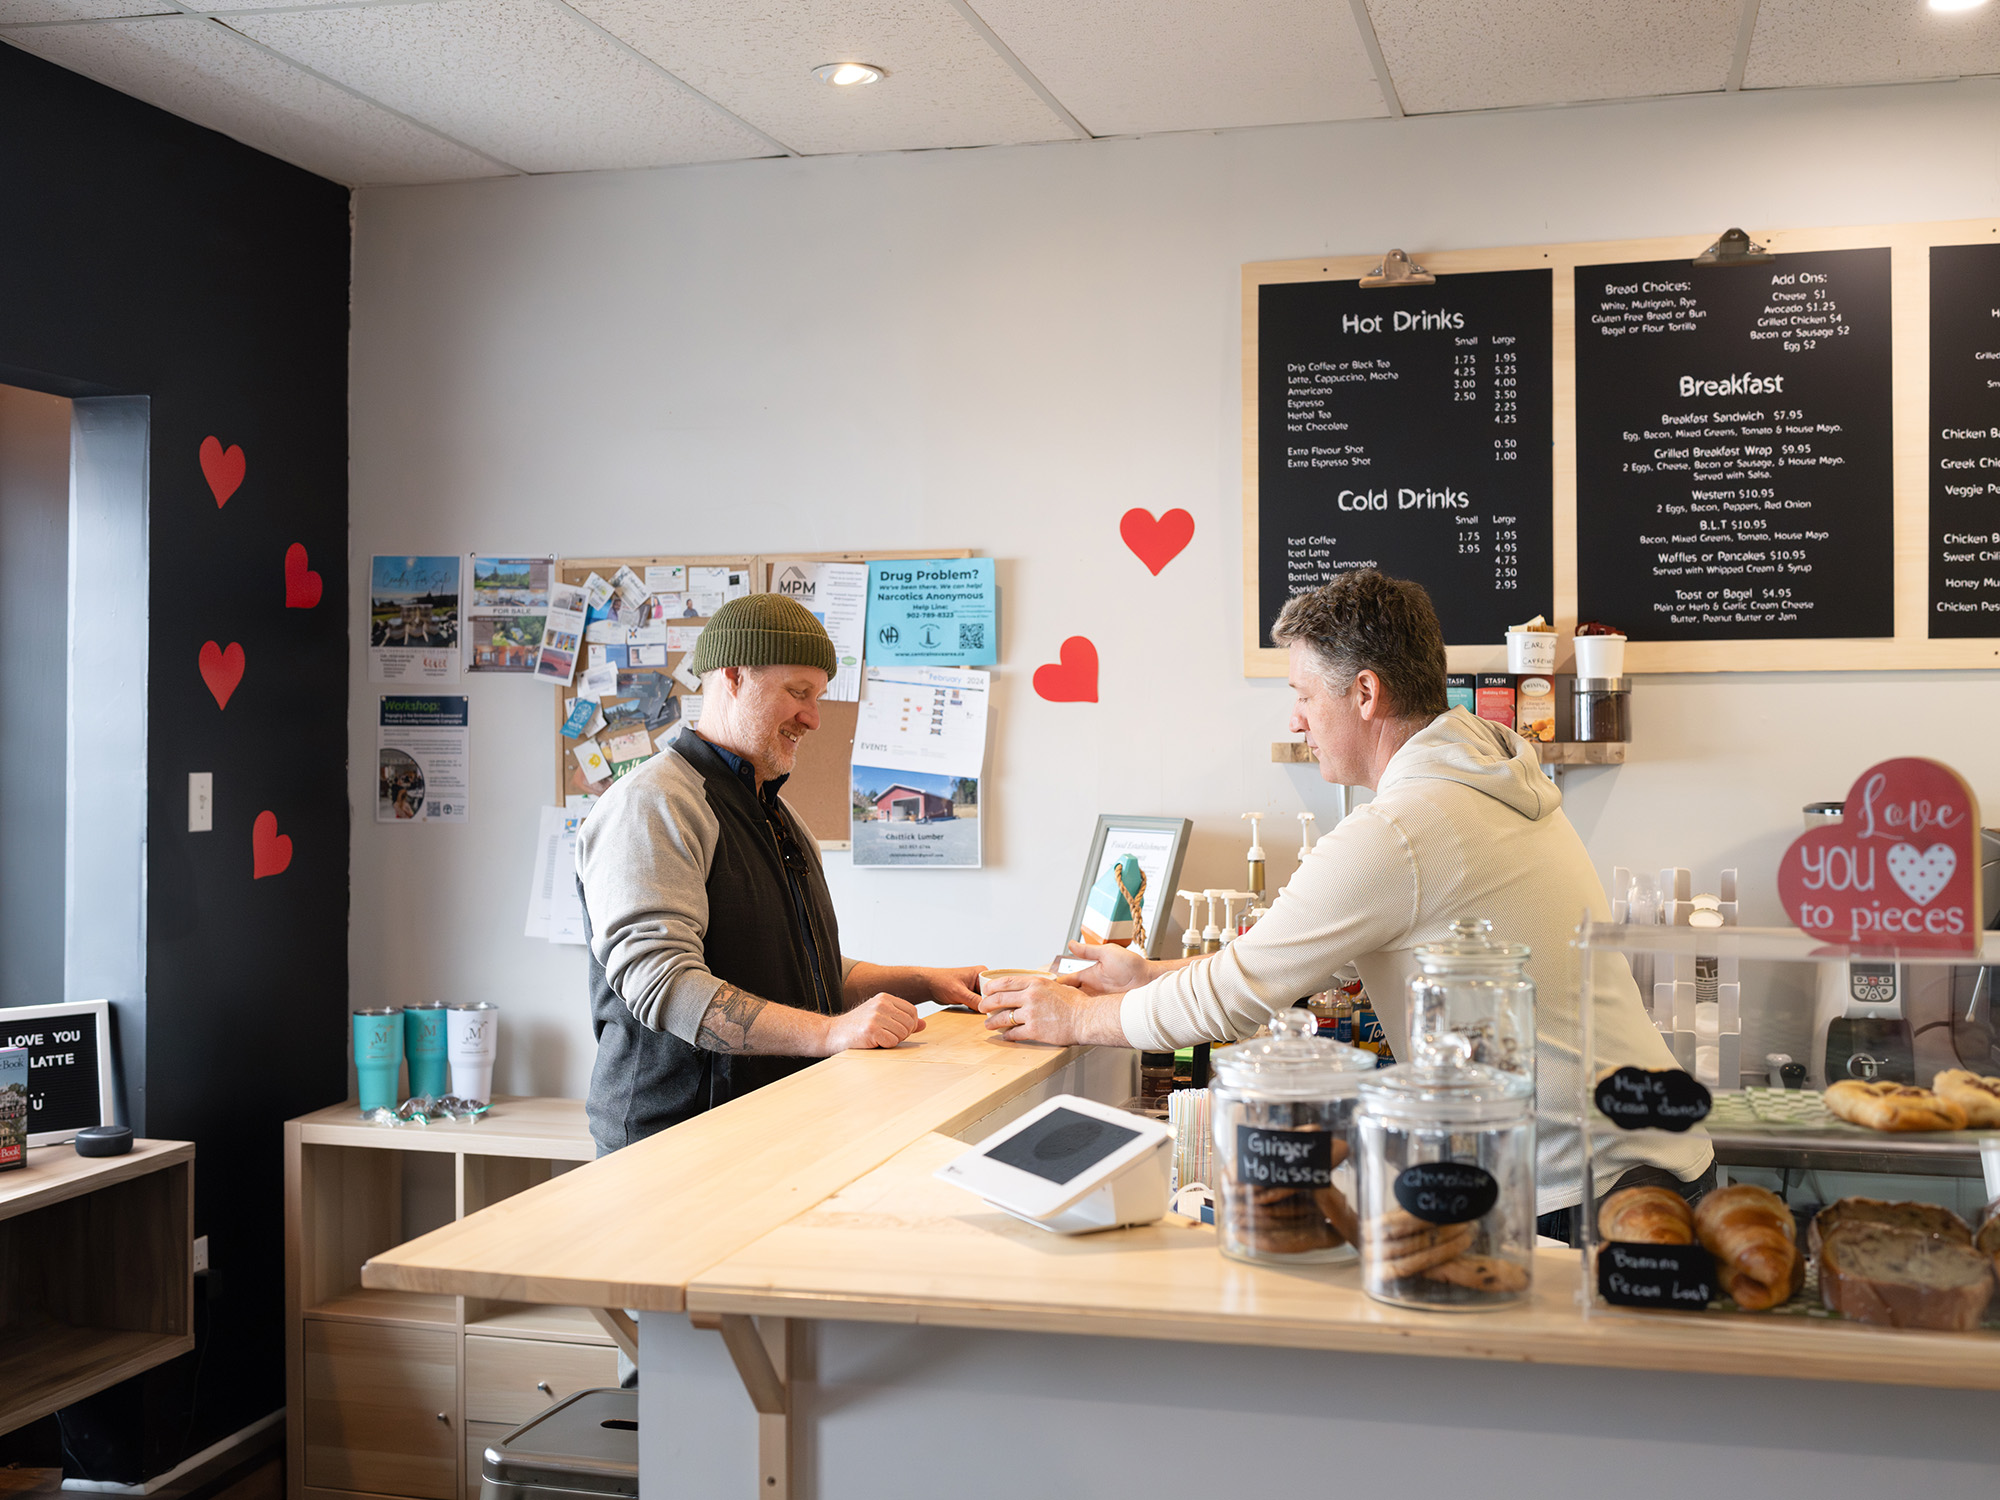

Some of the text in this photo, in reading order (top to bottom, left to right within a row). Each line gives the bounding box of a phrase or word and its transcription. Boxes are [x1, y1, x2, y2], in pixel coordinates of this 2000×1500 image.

[1771, 272, 1827, 285] Add Ons:
[1605, 281, 1691, 295] Bread Choices:
[1772, 289, 1825, 301] Cheese $1
[1764, 301, 1836, 314] Avocado $1.25
[1342, 308, 1464, 334] Hot Drinks
[1757, 313, 1842, 327] Grilled Chicken $4
[1455, 336, 1516, 346] Small Large
[1784, 340, 1816, 352] Egg $2
[1455, 353, 1516, 364] 1.75 1.95
[1287, 363, 1306, 373] Drip
[1308, 362, 1336, 371] Coffee
[1352, 360, 1373, 369] Black
[1376, 359, 1390, 368] Tea
[1454, 365, 1517, 376] 4.25 5.25
[1288, 371, 1399, 384] Latte, Cappuccino, Mocha
[1454, 378, 1516, 389] 3.00 4.00
[1679, 372, 1784, 397] Breakfast
[1288, 387, 1333, 396] Americano
[1454, 390, 1517, 401] 2.50 3.50
[1287, 399, 1325, 409] Espresso
[1495, 402, 1517, 412] 2.25
[1287, 410, 1332, 420] Herbal Tea
[1494, 414, 1517, 423] 4.25
[1661, 410, 1803, 425] Breakfast Sandwich $7.95
[1287, 422, 1348, 432] Hot Chocolate
[1942, 429, 1986, 439] Chicken
[1494, 439, 1517, 448] 0.50
[1287, 445, 1364, 456] Extra Flavour Shot
[1496, 451, 1517, 461] 1.00
[1654, 444, 1811, 459] Grilled Breakfast Wrap $9.95
[1287, 457, 1371, 469] Extra Espresso Shot
[1941, 458, 1975, 469] Greek
[1692, 488, 1774, 500] Western $10.95
[1945, 484, 1983, 498] Veggie
[1338, 487, 1469, 511] Cold Drinks
[1455, 515, 1516, 525] Small Large
[1700, 519, 1767, 530] B.L.T $10.95
[1288, 536, 1336, 546] Iced Coffee
[1459, 531, 1517, 541] 1.75 1.95
[1943, 533, 1988, 544] Chicken
[1288, 549, 1330, 558] Iced Latte
[1458, 543, 1517, 554] 3.95 4.95
[1495, 555, 1517, 565] 4.75
[1658, 550, 1806, 563] Waffles or Pancakes $10.95
[1943, 552, 1975, 562] Sweet
[1288, 559, 1378, 570] Peach Tea Lemonade
[880, 569, 979, 583] Drug Problem?
[1288, 572, 1319, 582] Bottled
[1495, 568, 1517, 577] 2.50
[780, 581, 816, 595] MPM
[1495, 580, 1517, 589] 2.95
[1945, 578, 1980, 590] Honey
[878, 592, 984, 602] Narcotics Anonymous
[1675, 588, 1792, 601] Toast or Bagel $4.95
[1936, 602, 1978, 612] Chicken
[1524, 641, 1545, 650] EARL
[929, 673, 984, 685] February 2024
[384, 701, 440, 713] Workshop:
[860, 742, 888, 752] EVENTS
[1857, 773, 1966, 841] Love
[1799, 901, 1966, 942] to pieces
[8, 1030, 81, 1048] LOVE YOU
[374, 1031, 387, 1044] M
[30, 1053, 75, 1068] LATTE
[1248, 1132, 1314, 1163] Ginger
[1243, 1156, 1331, 1184] Molasses
